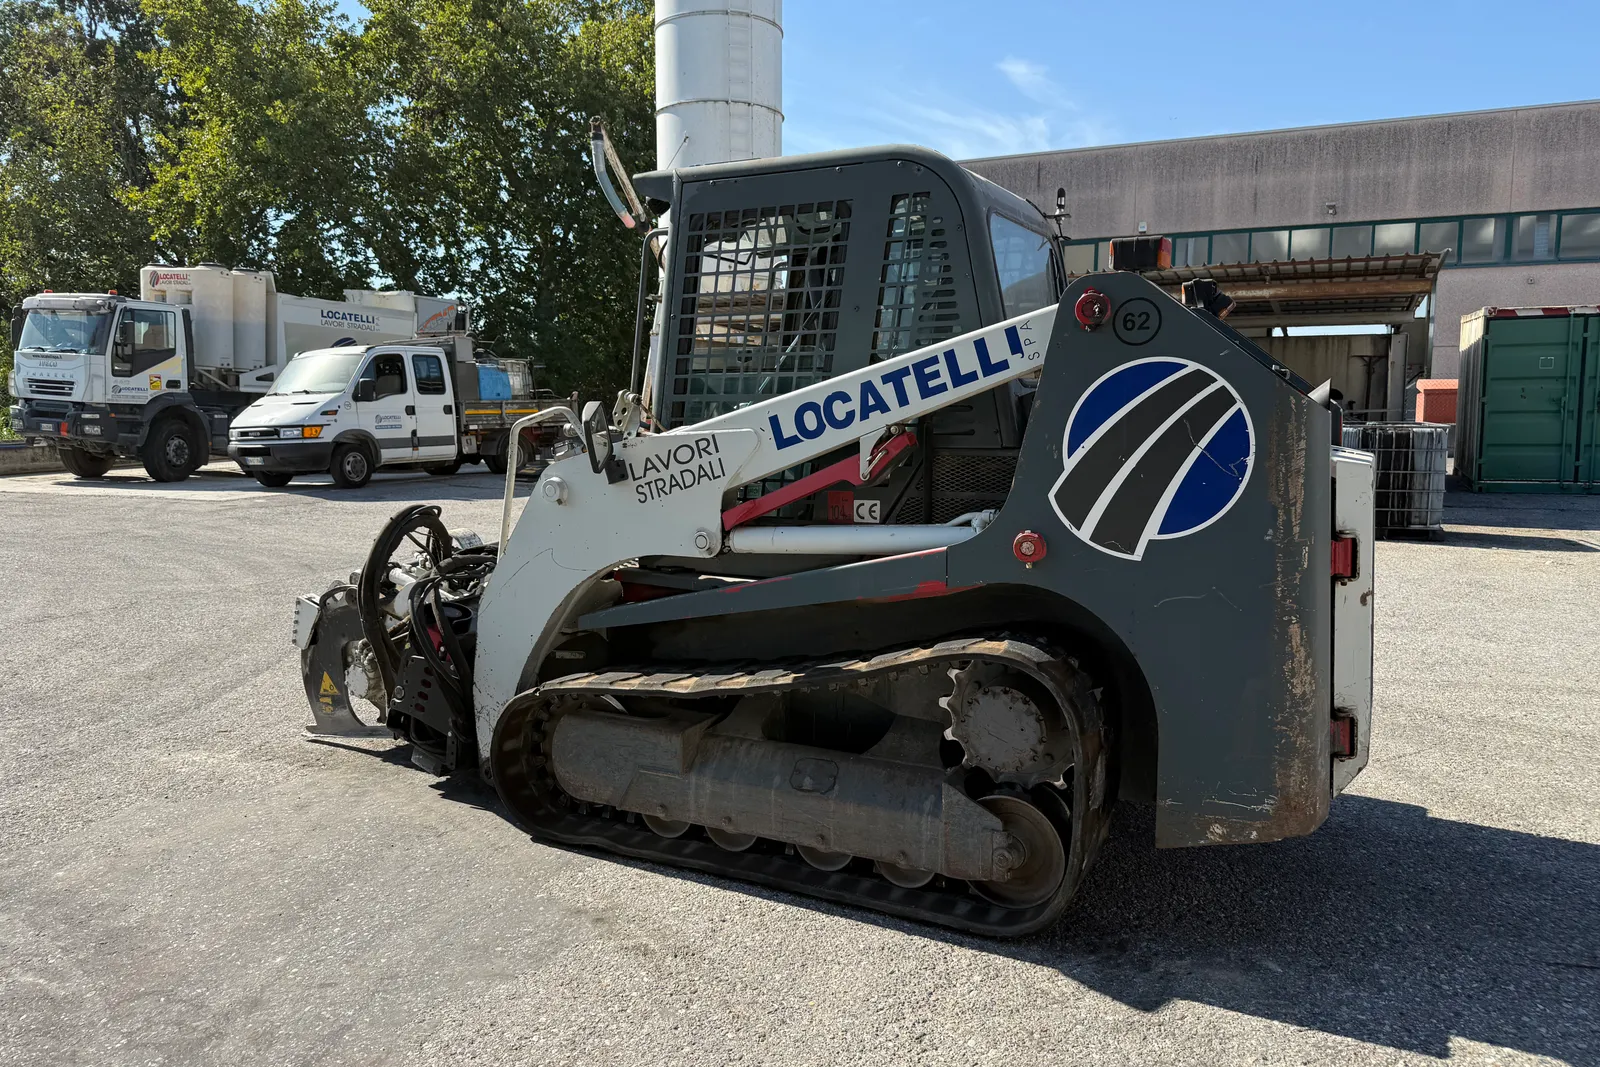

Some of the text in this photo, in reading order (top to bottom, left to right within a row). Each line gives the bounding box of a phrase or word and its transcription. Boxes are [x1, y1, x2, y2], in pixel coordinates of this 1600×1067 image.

[320, 309, 375, 324] LOCATELLI
[320, 319, 375, 332] LAVORI STRADALI
[1122, 311, 1150, 332] 62
[768, 325, 1024, 451] LOCATELLI
[628, 433, 720, 482] LAVORI
[635, 457, 726, 504] STRADALI
[855, 502, 878, 520] CE
